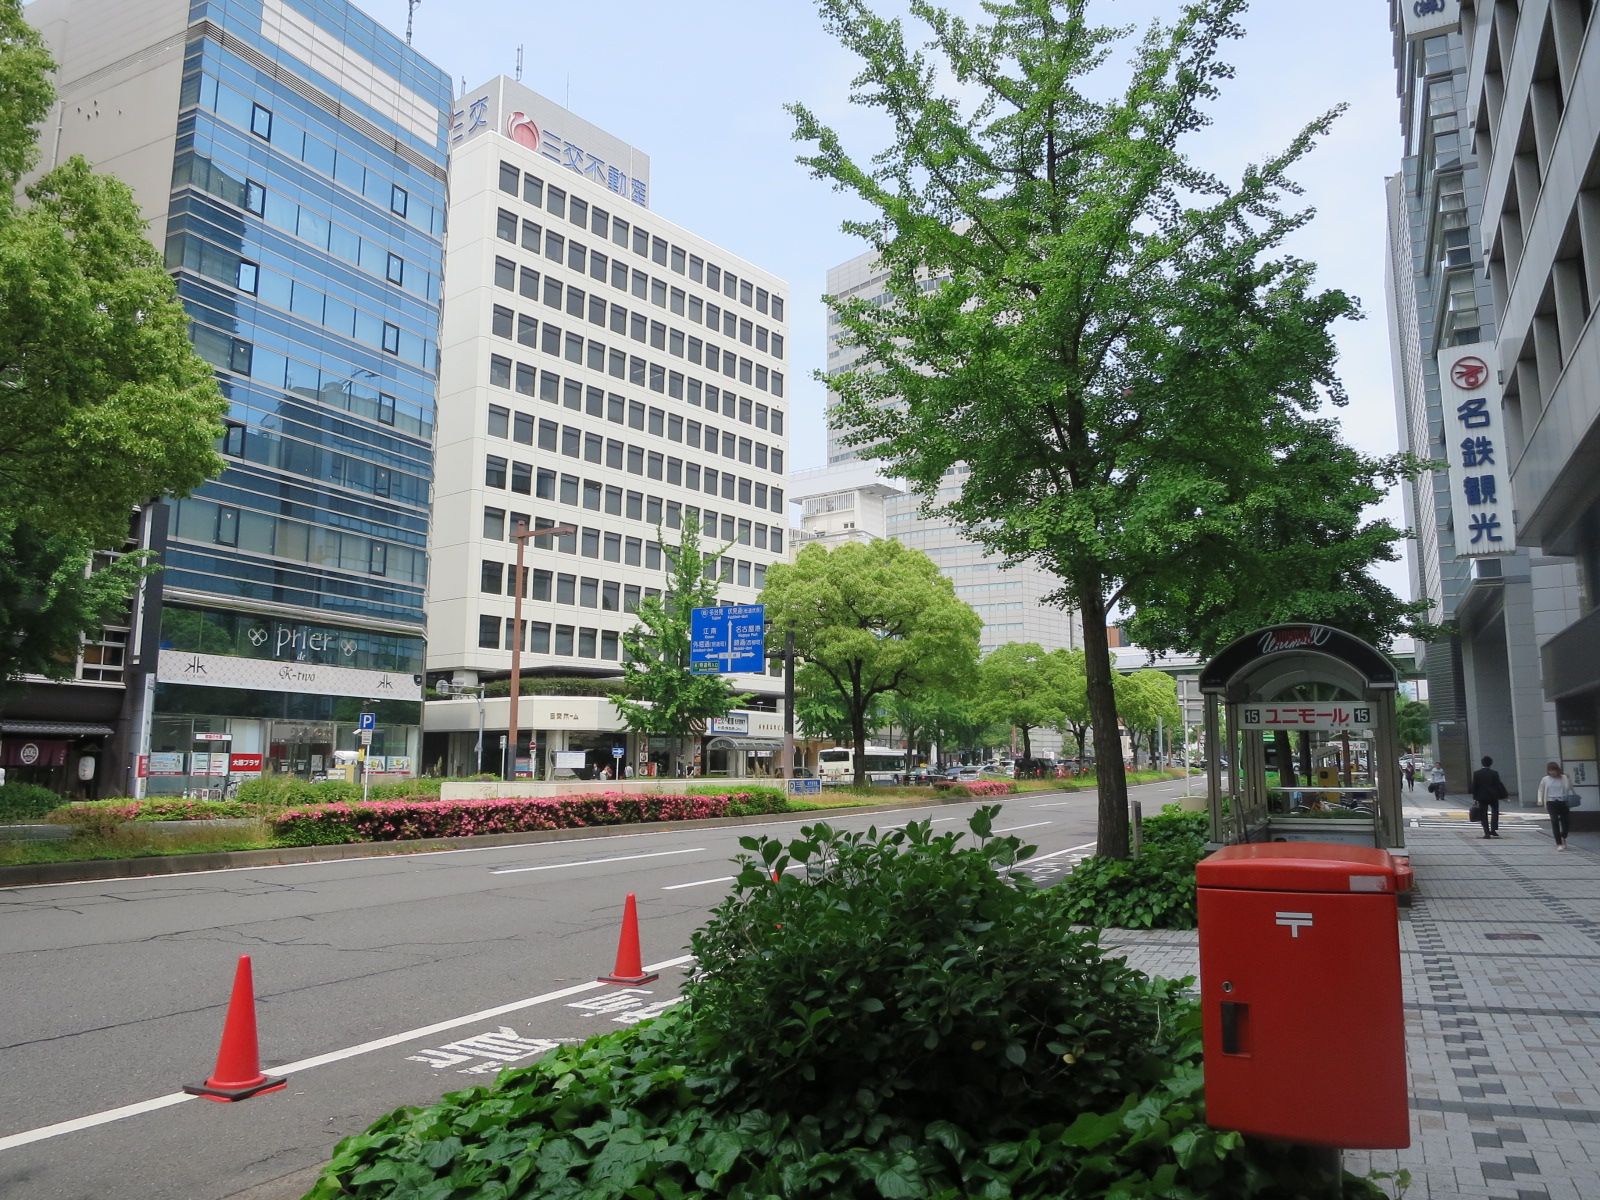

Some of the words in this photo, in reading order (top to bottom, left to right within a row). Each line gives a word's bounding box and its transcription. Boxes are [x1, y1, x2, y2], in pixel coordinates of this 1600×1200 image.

[542, 129, 646, 207] 三交不動産
[1456, 397, 1503, 544] 名鉄観光
[276, 624, 333, 656] prier
[278, 666, 316, 682] K-two
[363, 715, 372, 728] P
[1245, 710, 1259, 724] 15
[1265, 707, 1350, 724] ユニモール
[1355, 709, 1369, 722] 15
